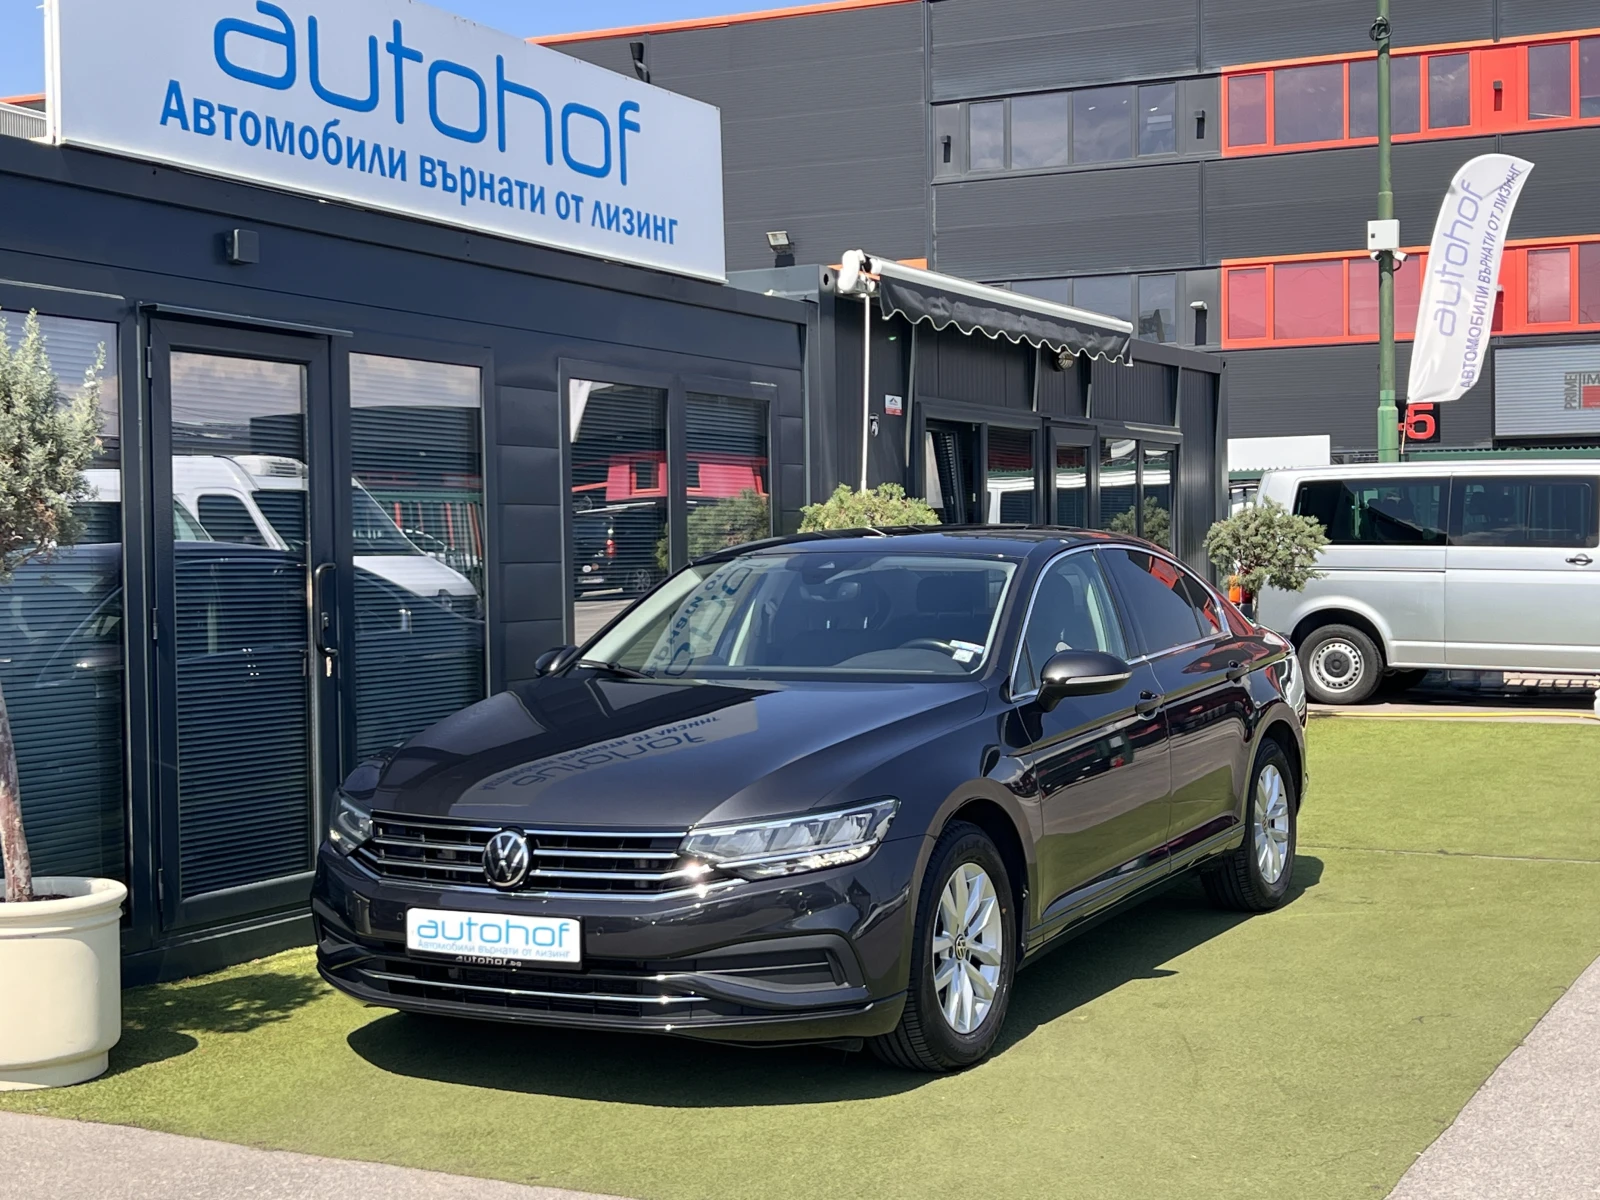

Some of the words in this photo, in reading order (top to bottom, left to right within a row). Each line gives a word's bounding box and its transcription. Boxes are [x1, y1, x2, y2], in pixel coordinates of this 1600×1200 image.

[213, 0, 641, 186] autohof
[159, 79, 407, 182] Автомобили
[419, 155, 545, 216] върнати
[555, 191, 584, 223] от
[591, 200, 678, 244] лизинг
[1493, 163, 1522, 213] ЛИЗИНГ
[1487, 211, 1501, 231] ОТ
[1434, 179, 1483, 337] autohof
[1477, 231, 1496, 284] ВЪРНАТИ
[1460, 284, 1489, 388] АВТОМОБИЛИ
[1564, 374, 1577, 410] PRIME
[1406, 402, 1436, 440] 5
[416, 917, 570, 948] autohof
[417, 940, 476, 954] Автомобили
[477, 945, 519, 957] върнати
[521, 947, 532, 957] от
[535, 949, 571, 959] лизинг
